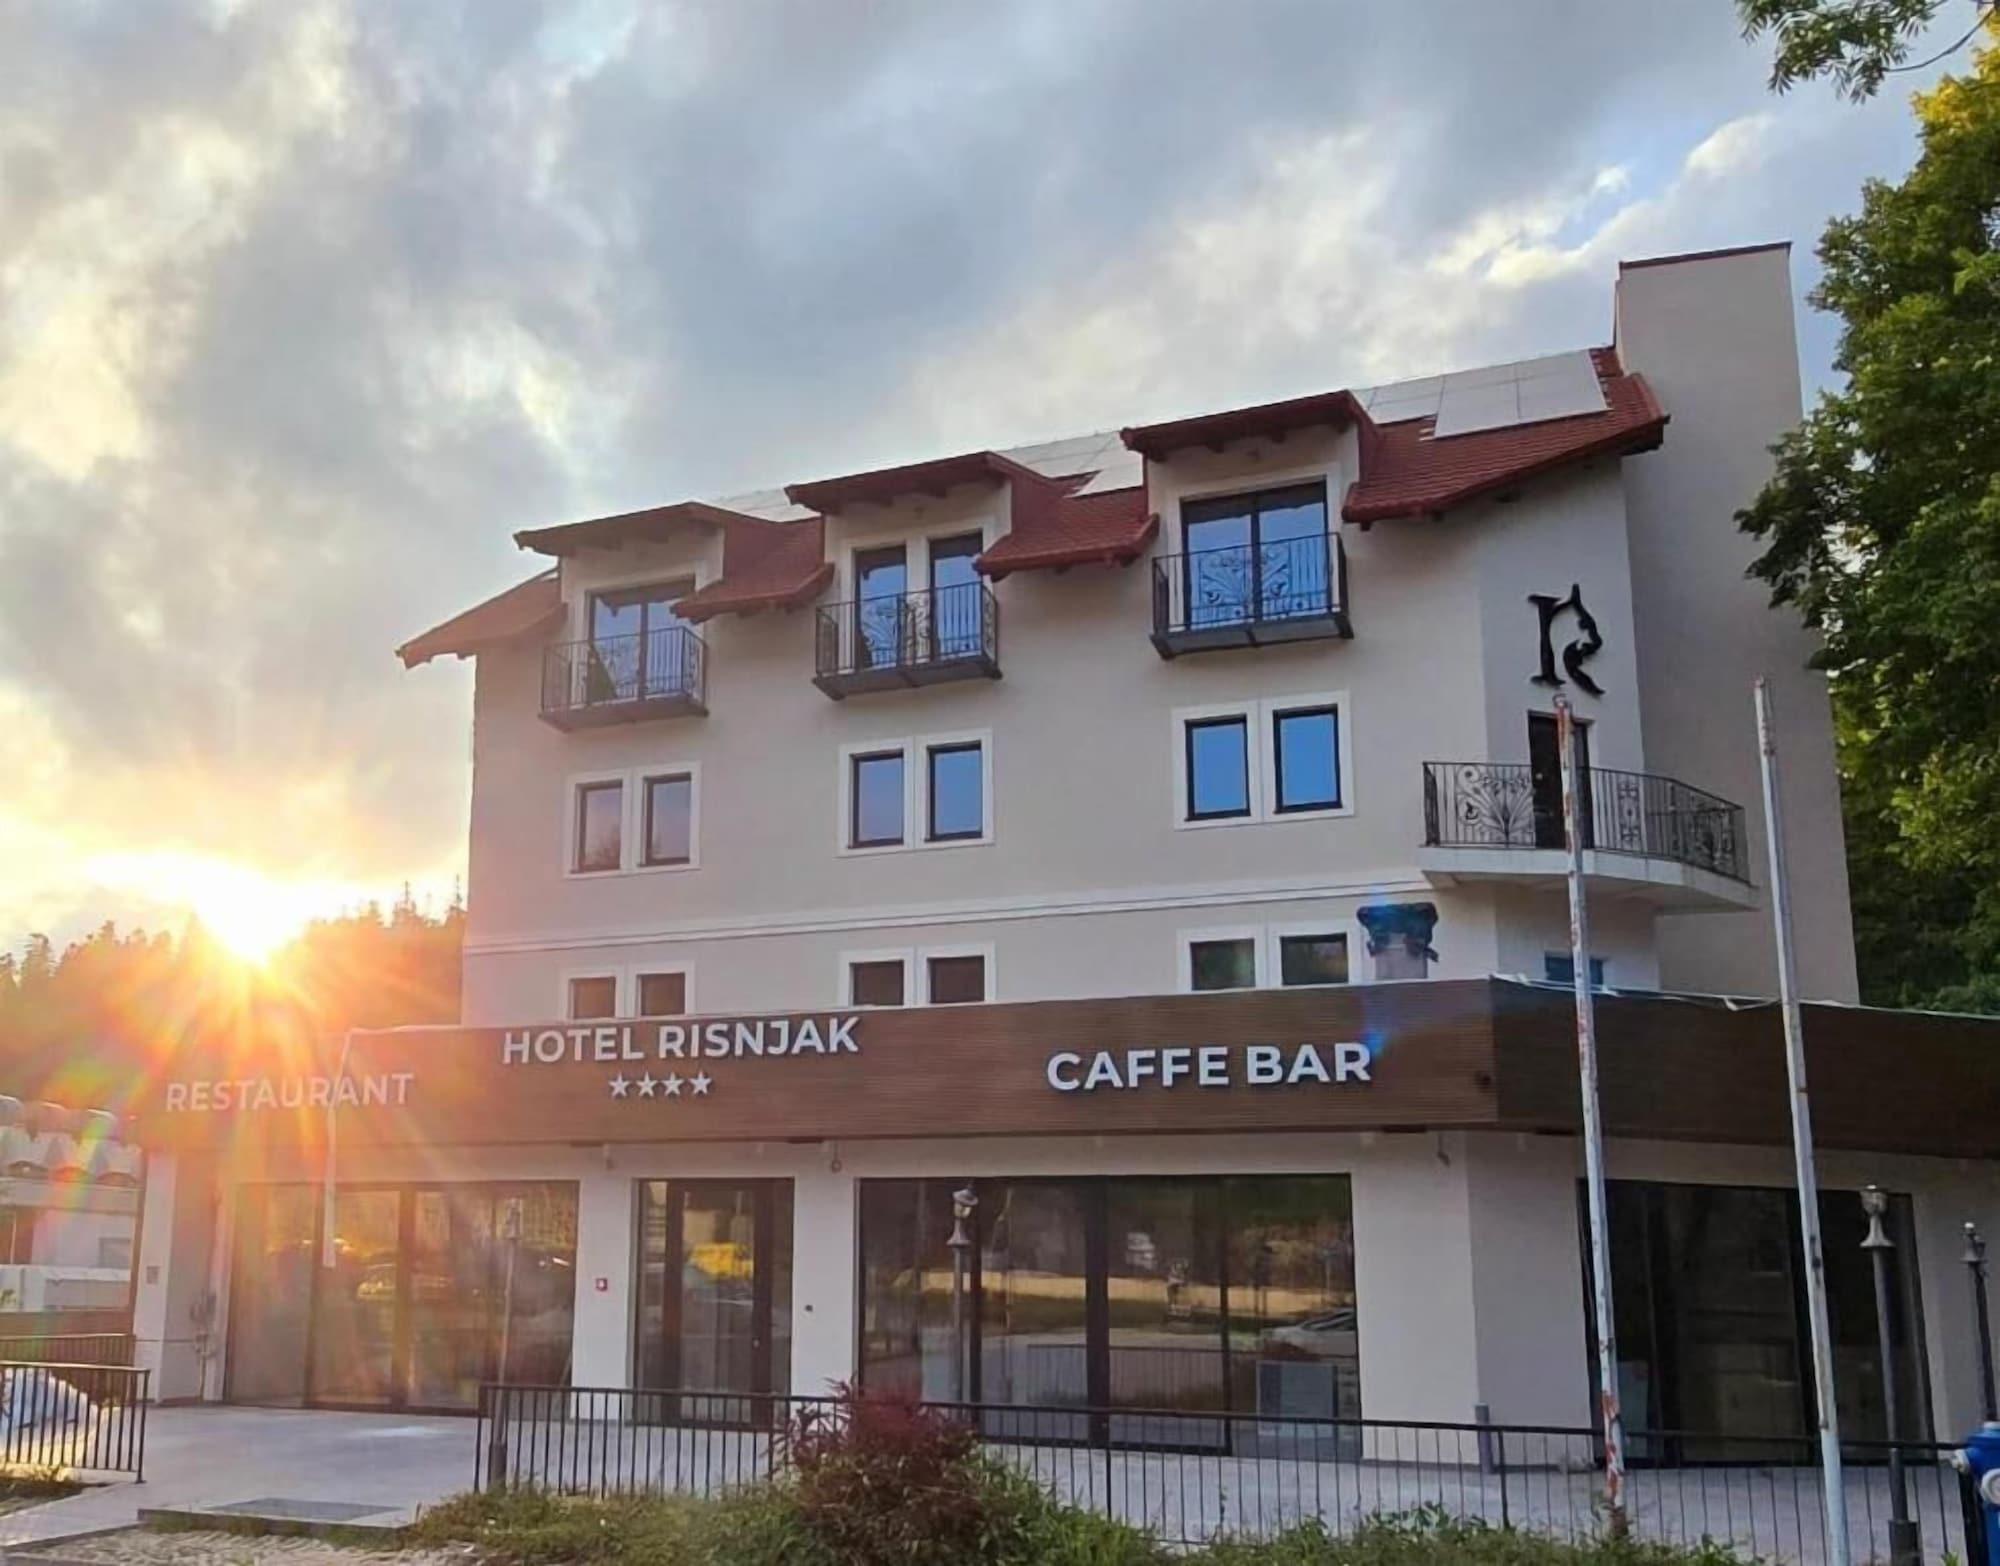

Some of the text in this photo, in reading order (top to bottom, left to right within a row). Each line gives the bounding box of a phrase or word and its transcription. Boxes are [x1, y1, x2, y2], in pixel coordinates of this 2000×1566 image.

[503, 1017, 860, 1064] HOTEL RISNJAK
[1047, 1041, 1372, 1091] CAFFE BAR
[166, 1072, 414, 1112] RESTAURANT
